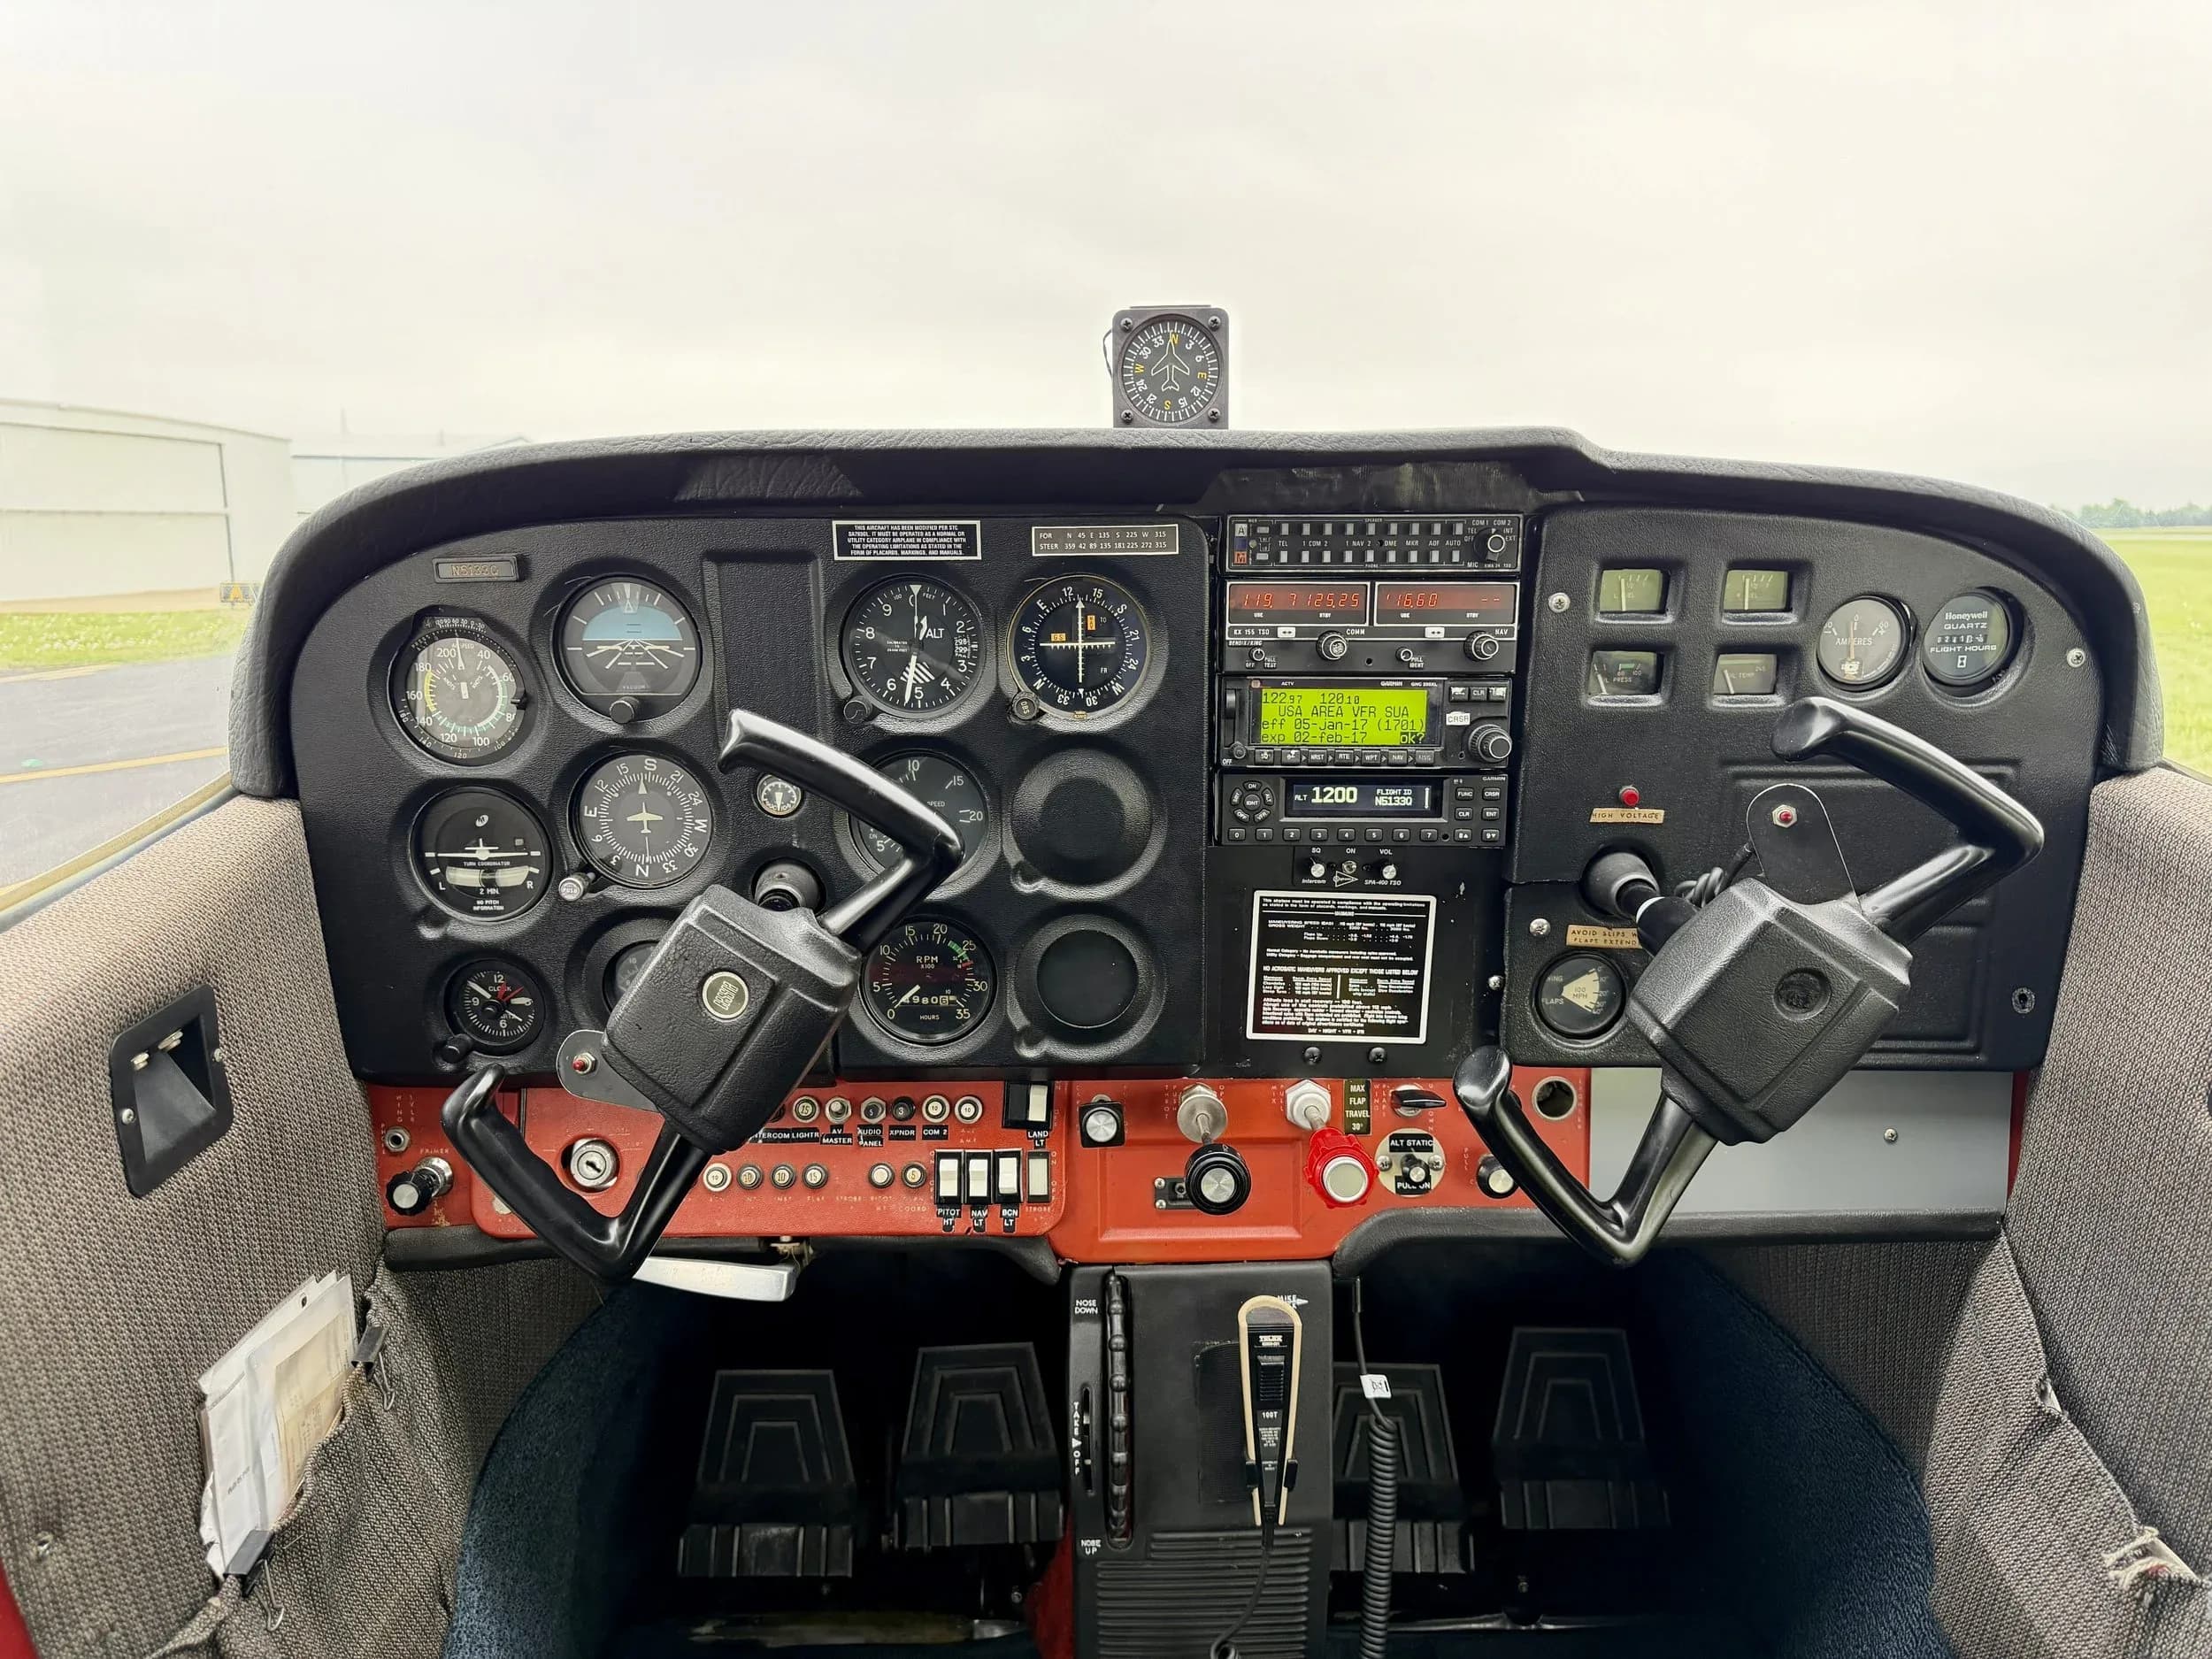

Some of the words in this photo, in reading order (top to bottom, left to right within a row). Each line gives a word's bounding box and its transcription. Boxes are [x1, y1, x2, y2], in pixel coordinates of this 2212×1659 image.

[1152, 336, 1164, 347] 33
[1171, 334, 1179, 344] N
[1185, 340, 1194, 349] 3
[1140, 347, 1151, 359] 30
[1135, 363, 1145, 373] W
[1135, 379, 1148, 392] 24
[1190, 386, 1202, 396] 12
[1147, 393, 1157, 403] 21
[1179, 396, 1188, 408] 15
[1164, 400, 1171, 410] S
[1036, 599, 1048, 611] E
[1117, 603, 1127, 614] S
[1945, 611, 1987, 621] Honeywell
[865, 627, 875, 639] 8
[926, 628, 945, 638] ALT
[437, 648, 457, 658] 200
[477, 650, 490, 659] 40
[915, 687, 924, 699] 5
[1112, 682, 1125, 696] W
[406, 691, 422, 700] 160
[1279, 706, 1302, 718] USA
[1311, 706, 1344, 718] AREA
[1352, 706, 1377, 718] VFR
[1385, 707, 1409, 718] SUA
[1262, 718, 1286, 730] eff
[1294, 718, 1368, 731] 05-jan-17
[1378, 718, 1425, 732] (1701)
[1262, 733, 1286, 743] exp
[1294, 732, 1367, 743] 02-feb-17
[1400, 732, 1425, 744] ok?
[644, 758, 657, 772] S
[1311, 787, 1358, 803] 1200
[584, 805, 597, 818] E
[694, 819, 708, 833] W
[635, 864, 649, 877] N
[933, 924, 948, 934] 20
[494, 974, 504, 983] 12
